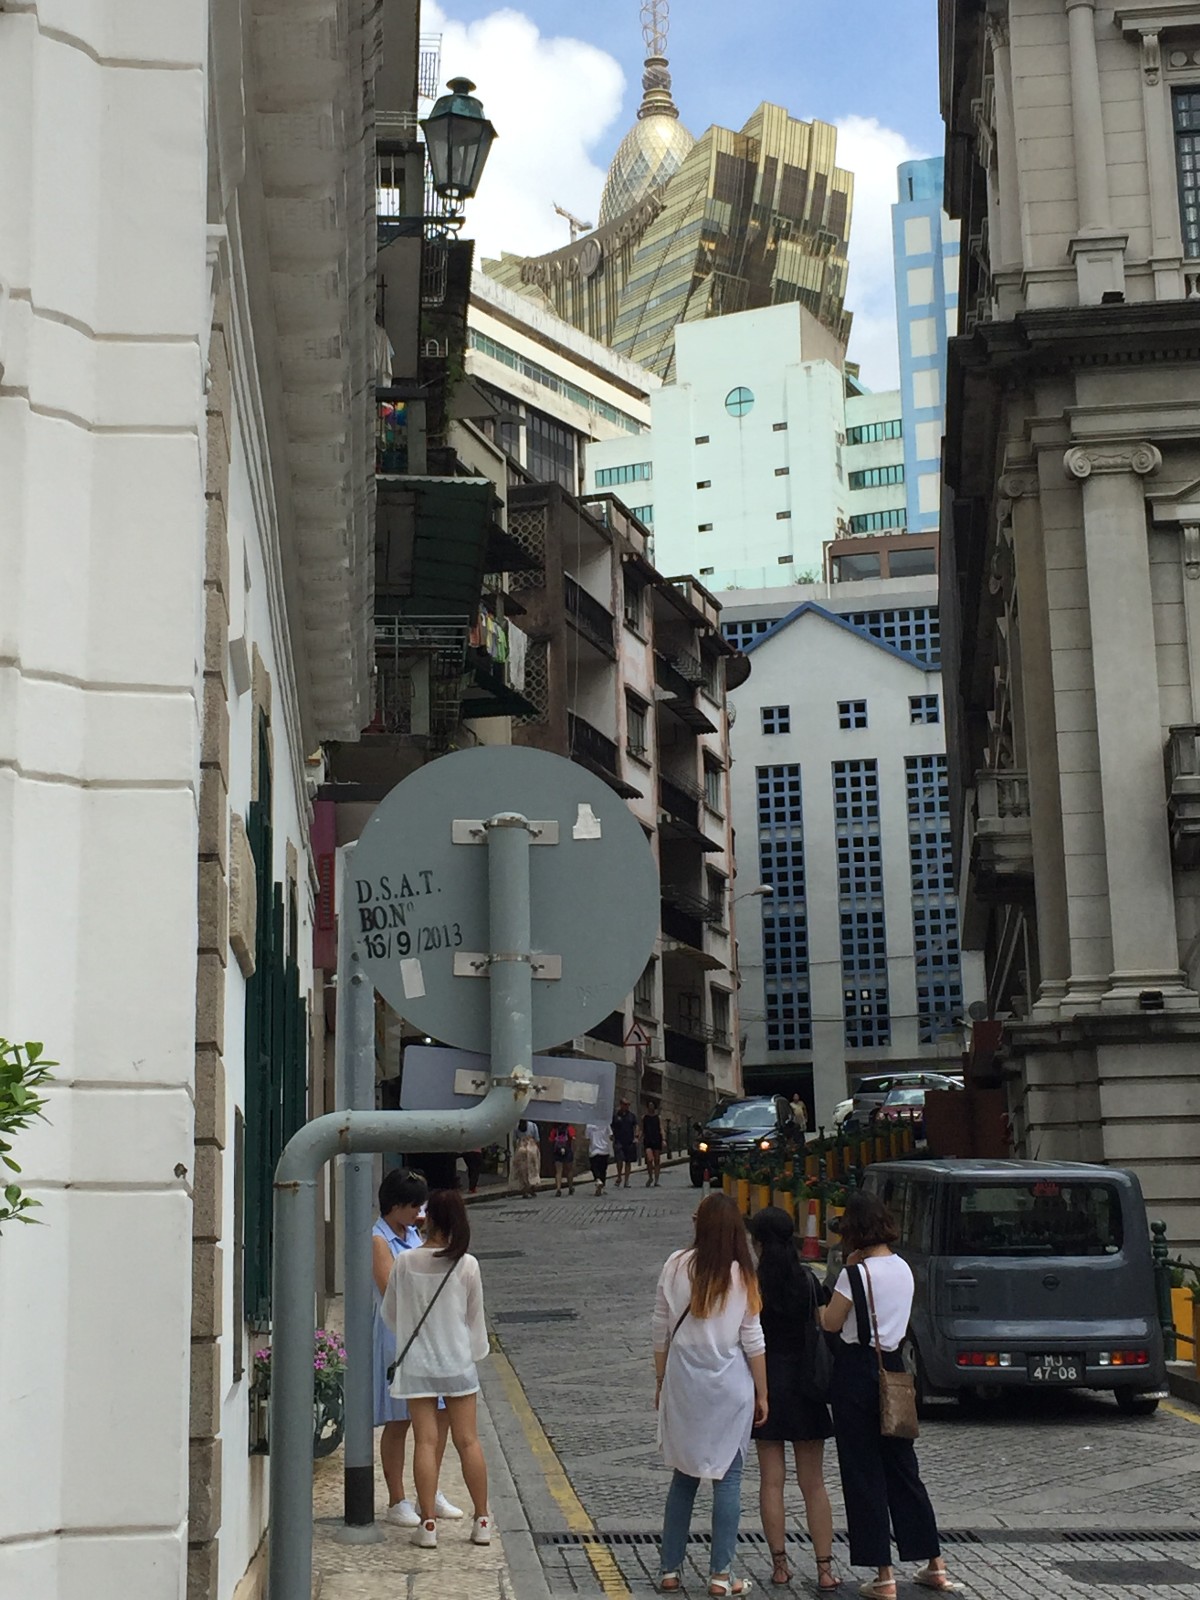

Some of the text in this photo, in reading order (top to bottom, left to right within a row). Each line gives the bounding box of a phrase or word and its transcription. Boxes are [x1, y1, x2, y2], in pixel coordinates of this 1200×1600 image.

[355, 870, 442, 904] D.S.A.T.
[1044, 1354, 1063, 1367] MJ
[1033, 1366, 1077, 1380] 47-08
